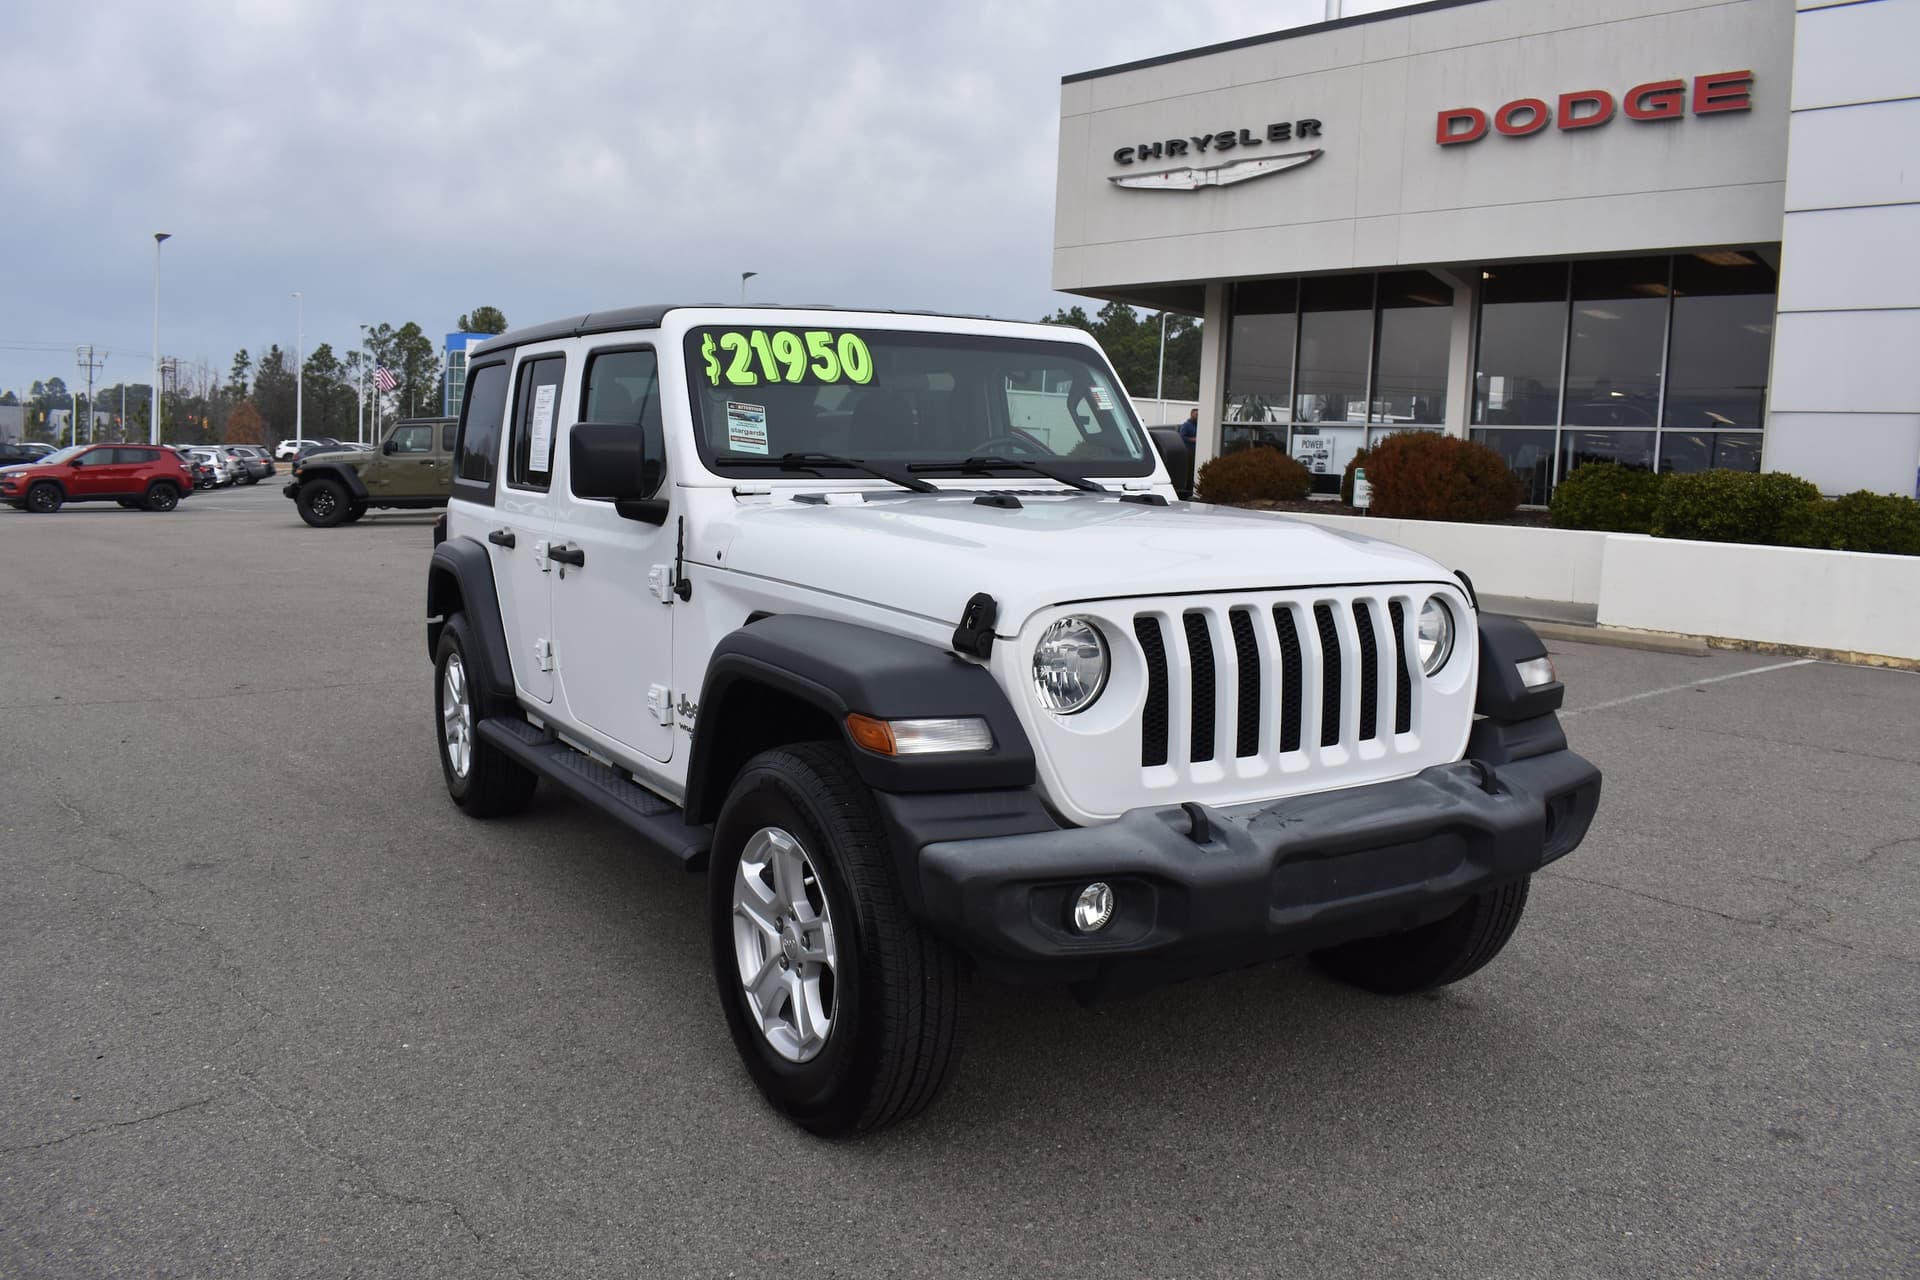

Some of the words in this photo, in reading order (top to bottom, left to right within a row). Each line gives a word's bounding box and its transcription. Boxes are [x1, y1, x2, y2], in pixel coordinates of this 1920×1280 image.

[1436, 70, 1754, 147] DODGE
[1113, 118, 1322, 165] CHRYSLER
[702, 330, 873, 386] $21950
[1301, 440, 1324, 449] POWER
